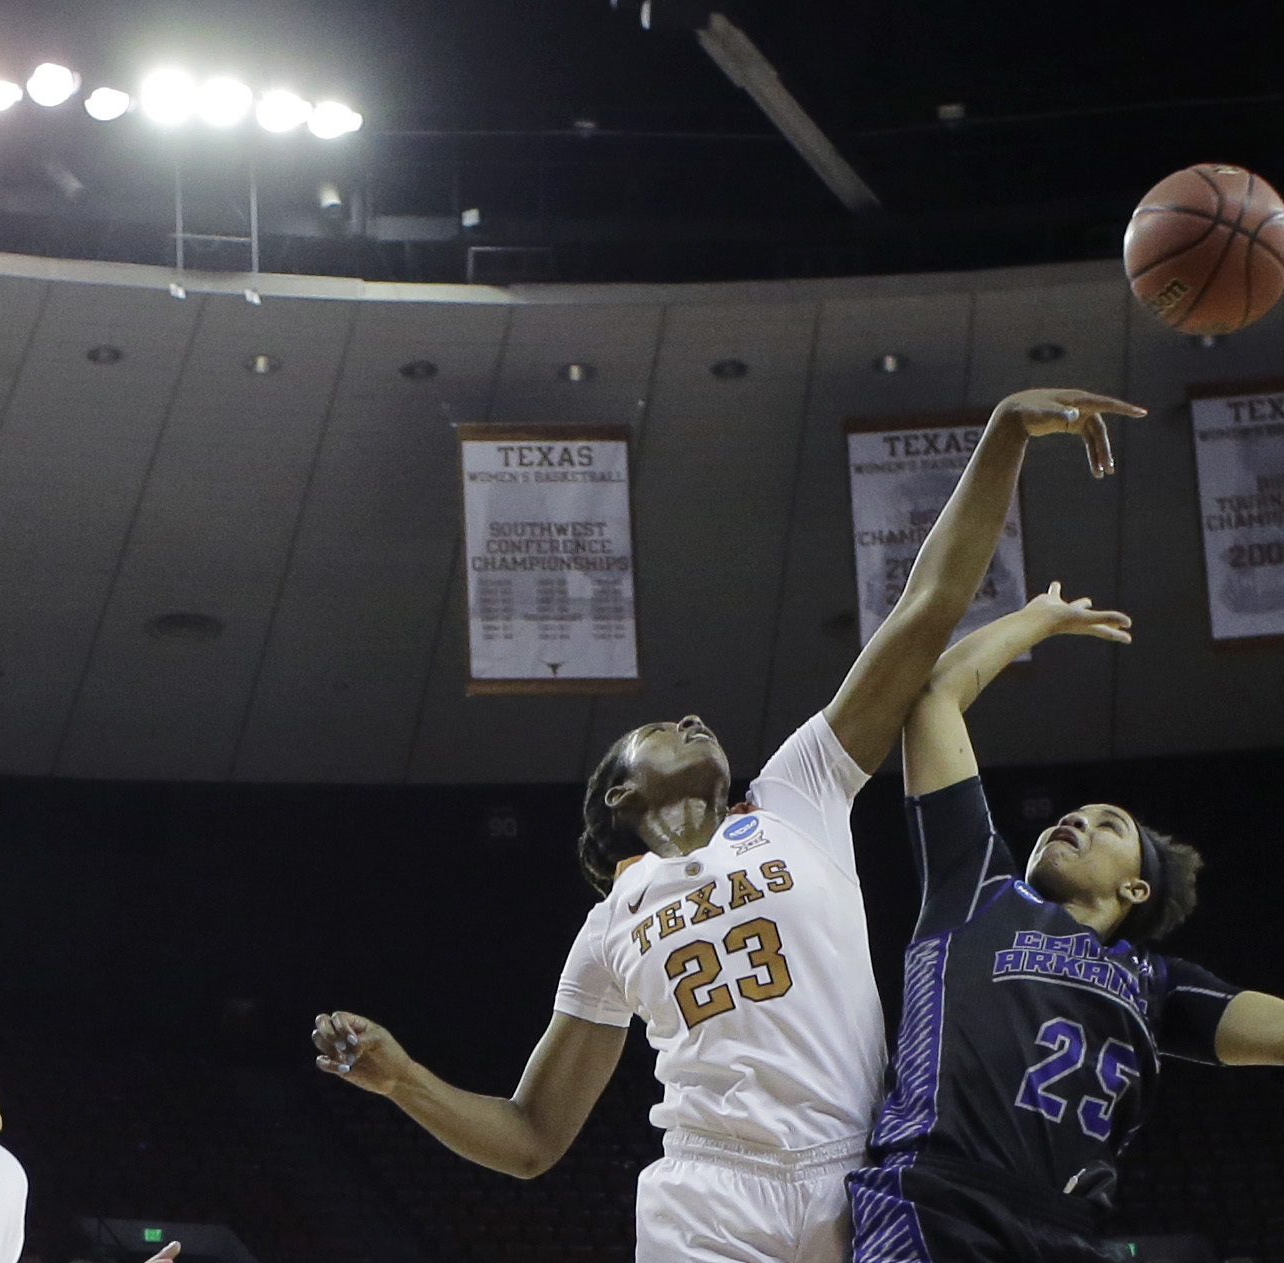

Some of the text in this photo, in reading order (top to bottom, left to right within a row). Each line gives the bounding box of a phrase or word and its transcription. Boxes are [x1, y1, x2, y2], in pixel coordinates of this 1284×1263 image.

[883, 430, 979, 457] TEXAS
[497, 445, 594, 467] TEXAS
[535, 471, 626, 483] BASKETBALL
[489, 522, 607, 537] SOUTHWEST
[486, 539, 612, 555] CONFERENCE
[471, 555, 629, 572] CHAMPIONSHIPS
[631, 859, 794, 956] TEXAS
[664, 917, 793, 1030] 23
[1014, 1017, 1140, 1142] 25
